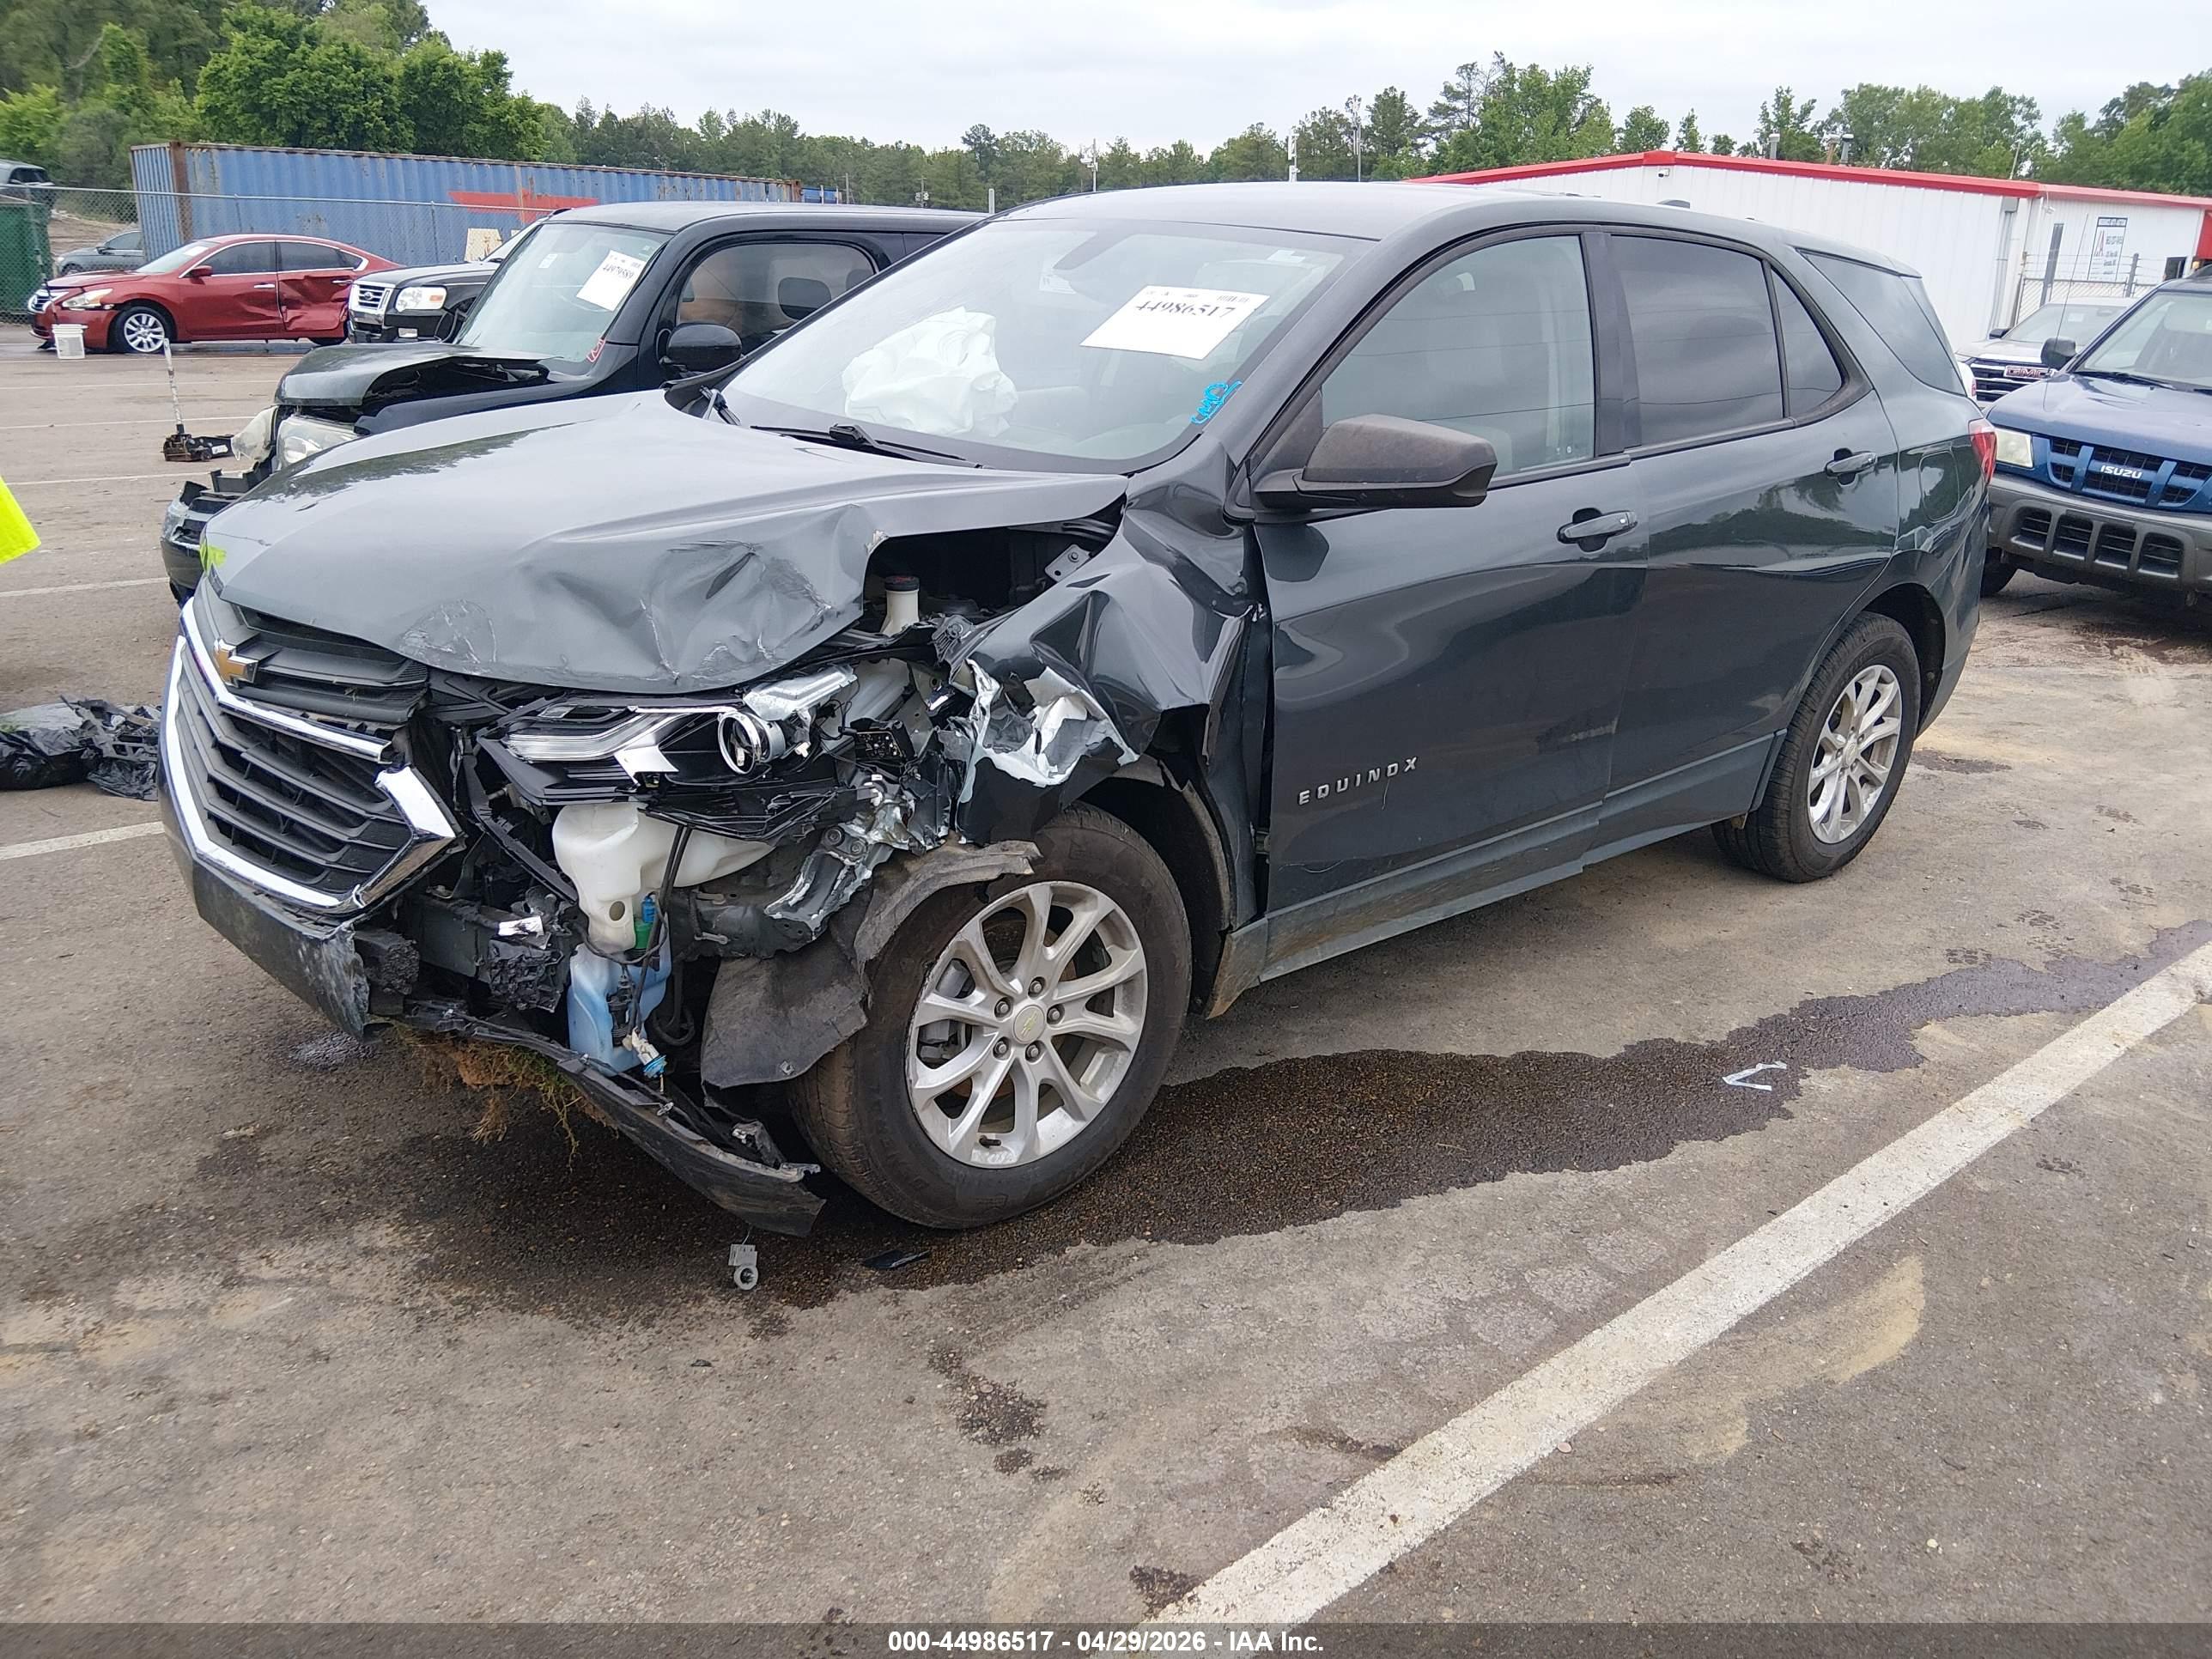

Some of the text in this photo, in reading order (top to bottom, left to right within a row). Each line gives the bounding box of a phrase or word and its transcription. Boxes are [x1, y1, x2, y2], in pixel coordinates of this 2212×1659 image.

[1135, 300, 1237, 319] 44986517
[2100, 465, 2143, 479] ISUZU
[1297, 757, 1418, 805] EQUINOX
